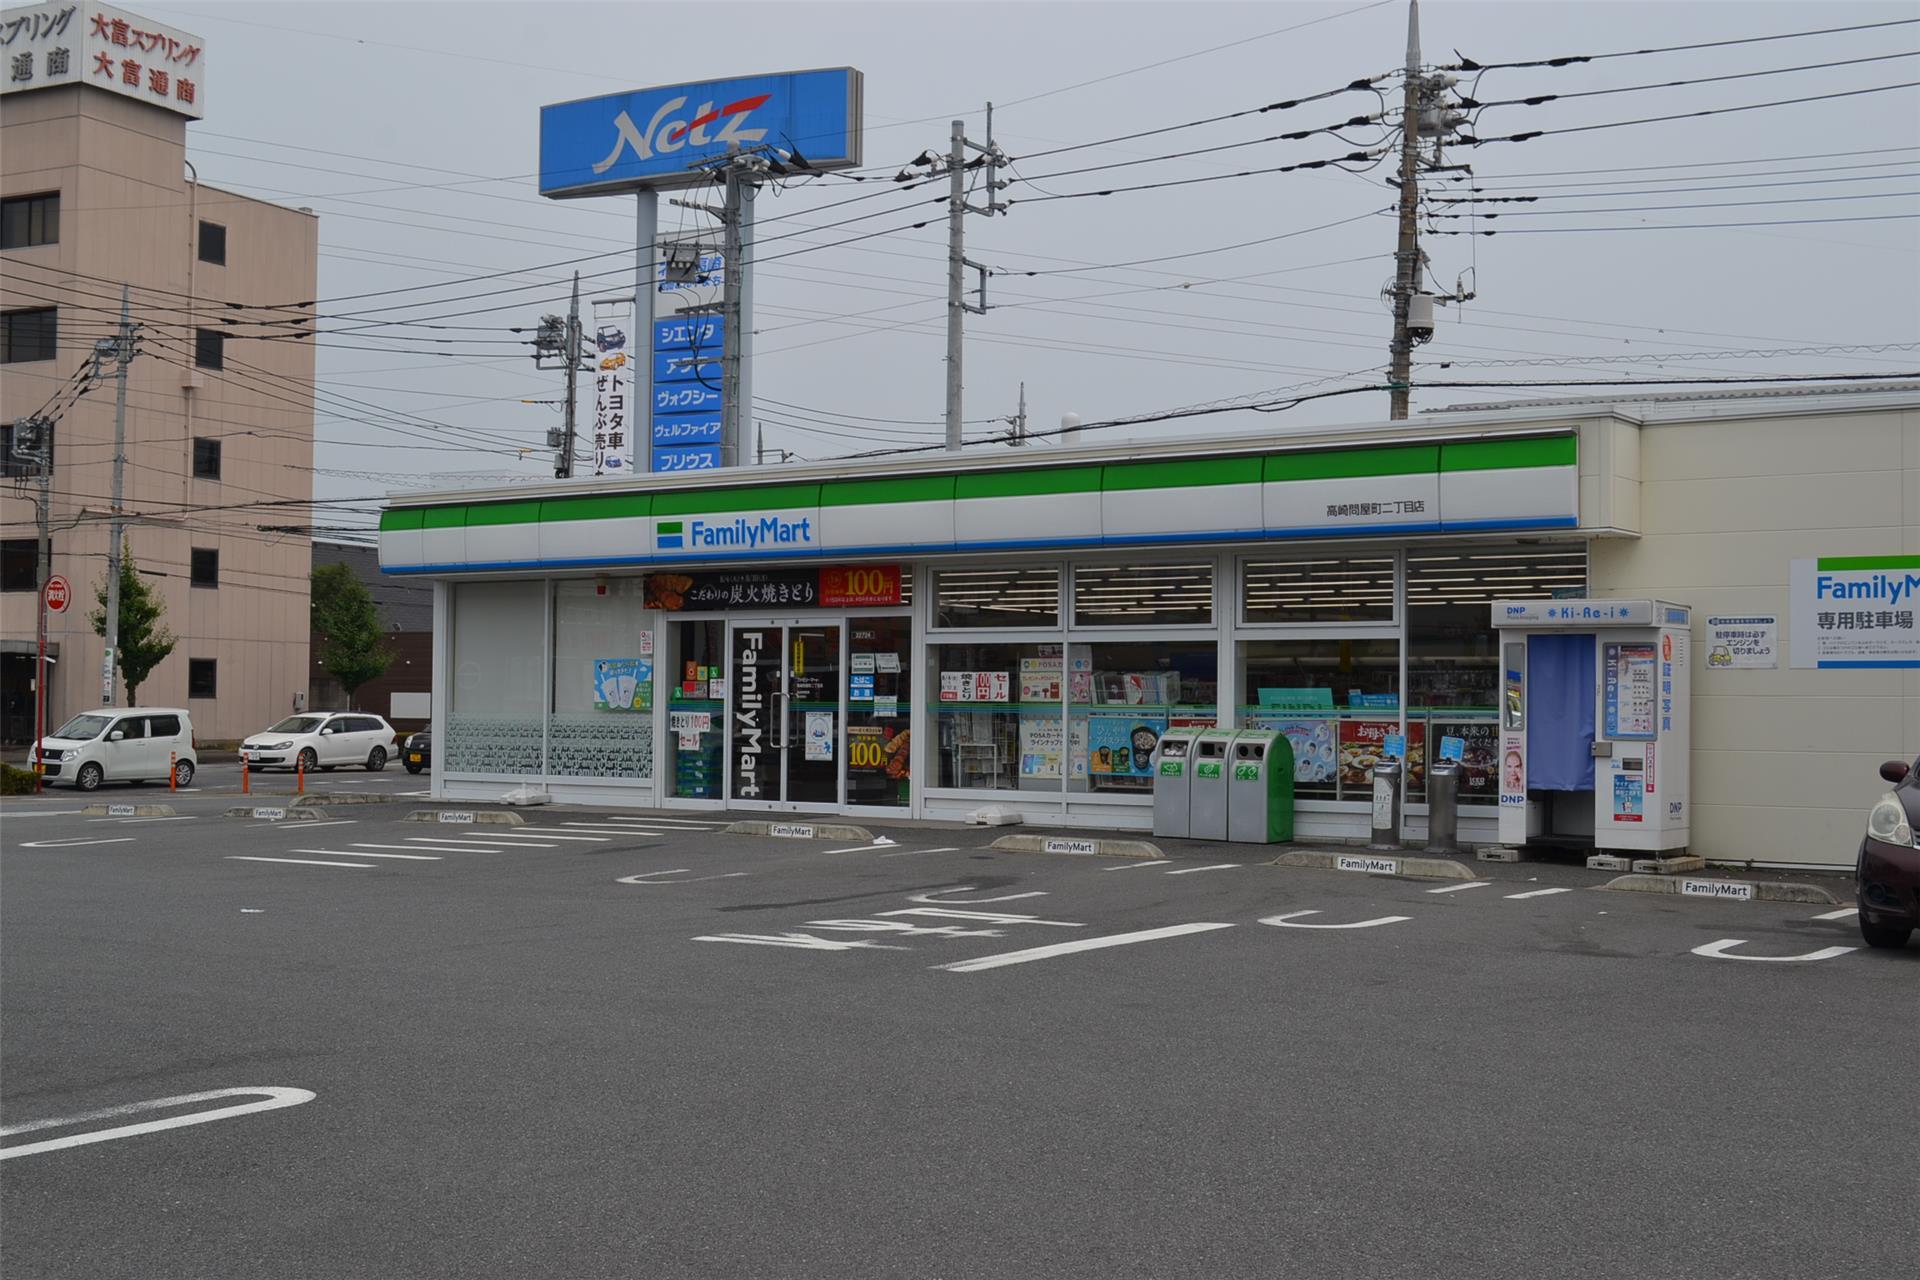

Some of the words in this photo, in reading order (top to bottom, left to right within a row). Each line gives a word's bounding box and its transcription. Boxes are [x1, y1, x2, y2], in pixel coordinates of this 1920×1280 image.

[90, 12, 201, 67] 大富スプリング
[93, 51, 196, 104] 大富通商
[592, 93, 774, 174] Netz
[661, 325, 714, 343] シエンタ
[657, 391, 718, 406] ヴォクシー
[607, 375, 624, 450] トヨタ車
[655, 421, 721, 437] ヴェルファイア
[660, 452, 713, 471] プリウス
[1326, 501, 1425, 517] 高崎問屋町二丁目店
[692, 517, 810, 548] FamilyMart
[846, 569, 894, 596] 100円
[1506, 607, 1526, 615] DNP
[1817, 611, 1914, 630] 専用駐車場
[994, 673, 1007, 699] セール
[736, 632, 763, 797] FamilyMart
[679, 735, 698, 747] セール
[849, 742, 888, 766] 100円
[1501, 795, 1525, 804] DNP
[1669, 802, 1682, 813] DNP
[255, 809, 282, 818] FamilyMart
[441, 812, 471, 821] FamilyMart
[773, 826, 811, 836] FamilyMart
[1047, 841, 1092, 852] FamilyMart
[1340, 859, 1393, 872] FamilyMart
[1685, 882, 1748, 896] FamilyMart
